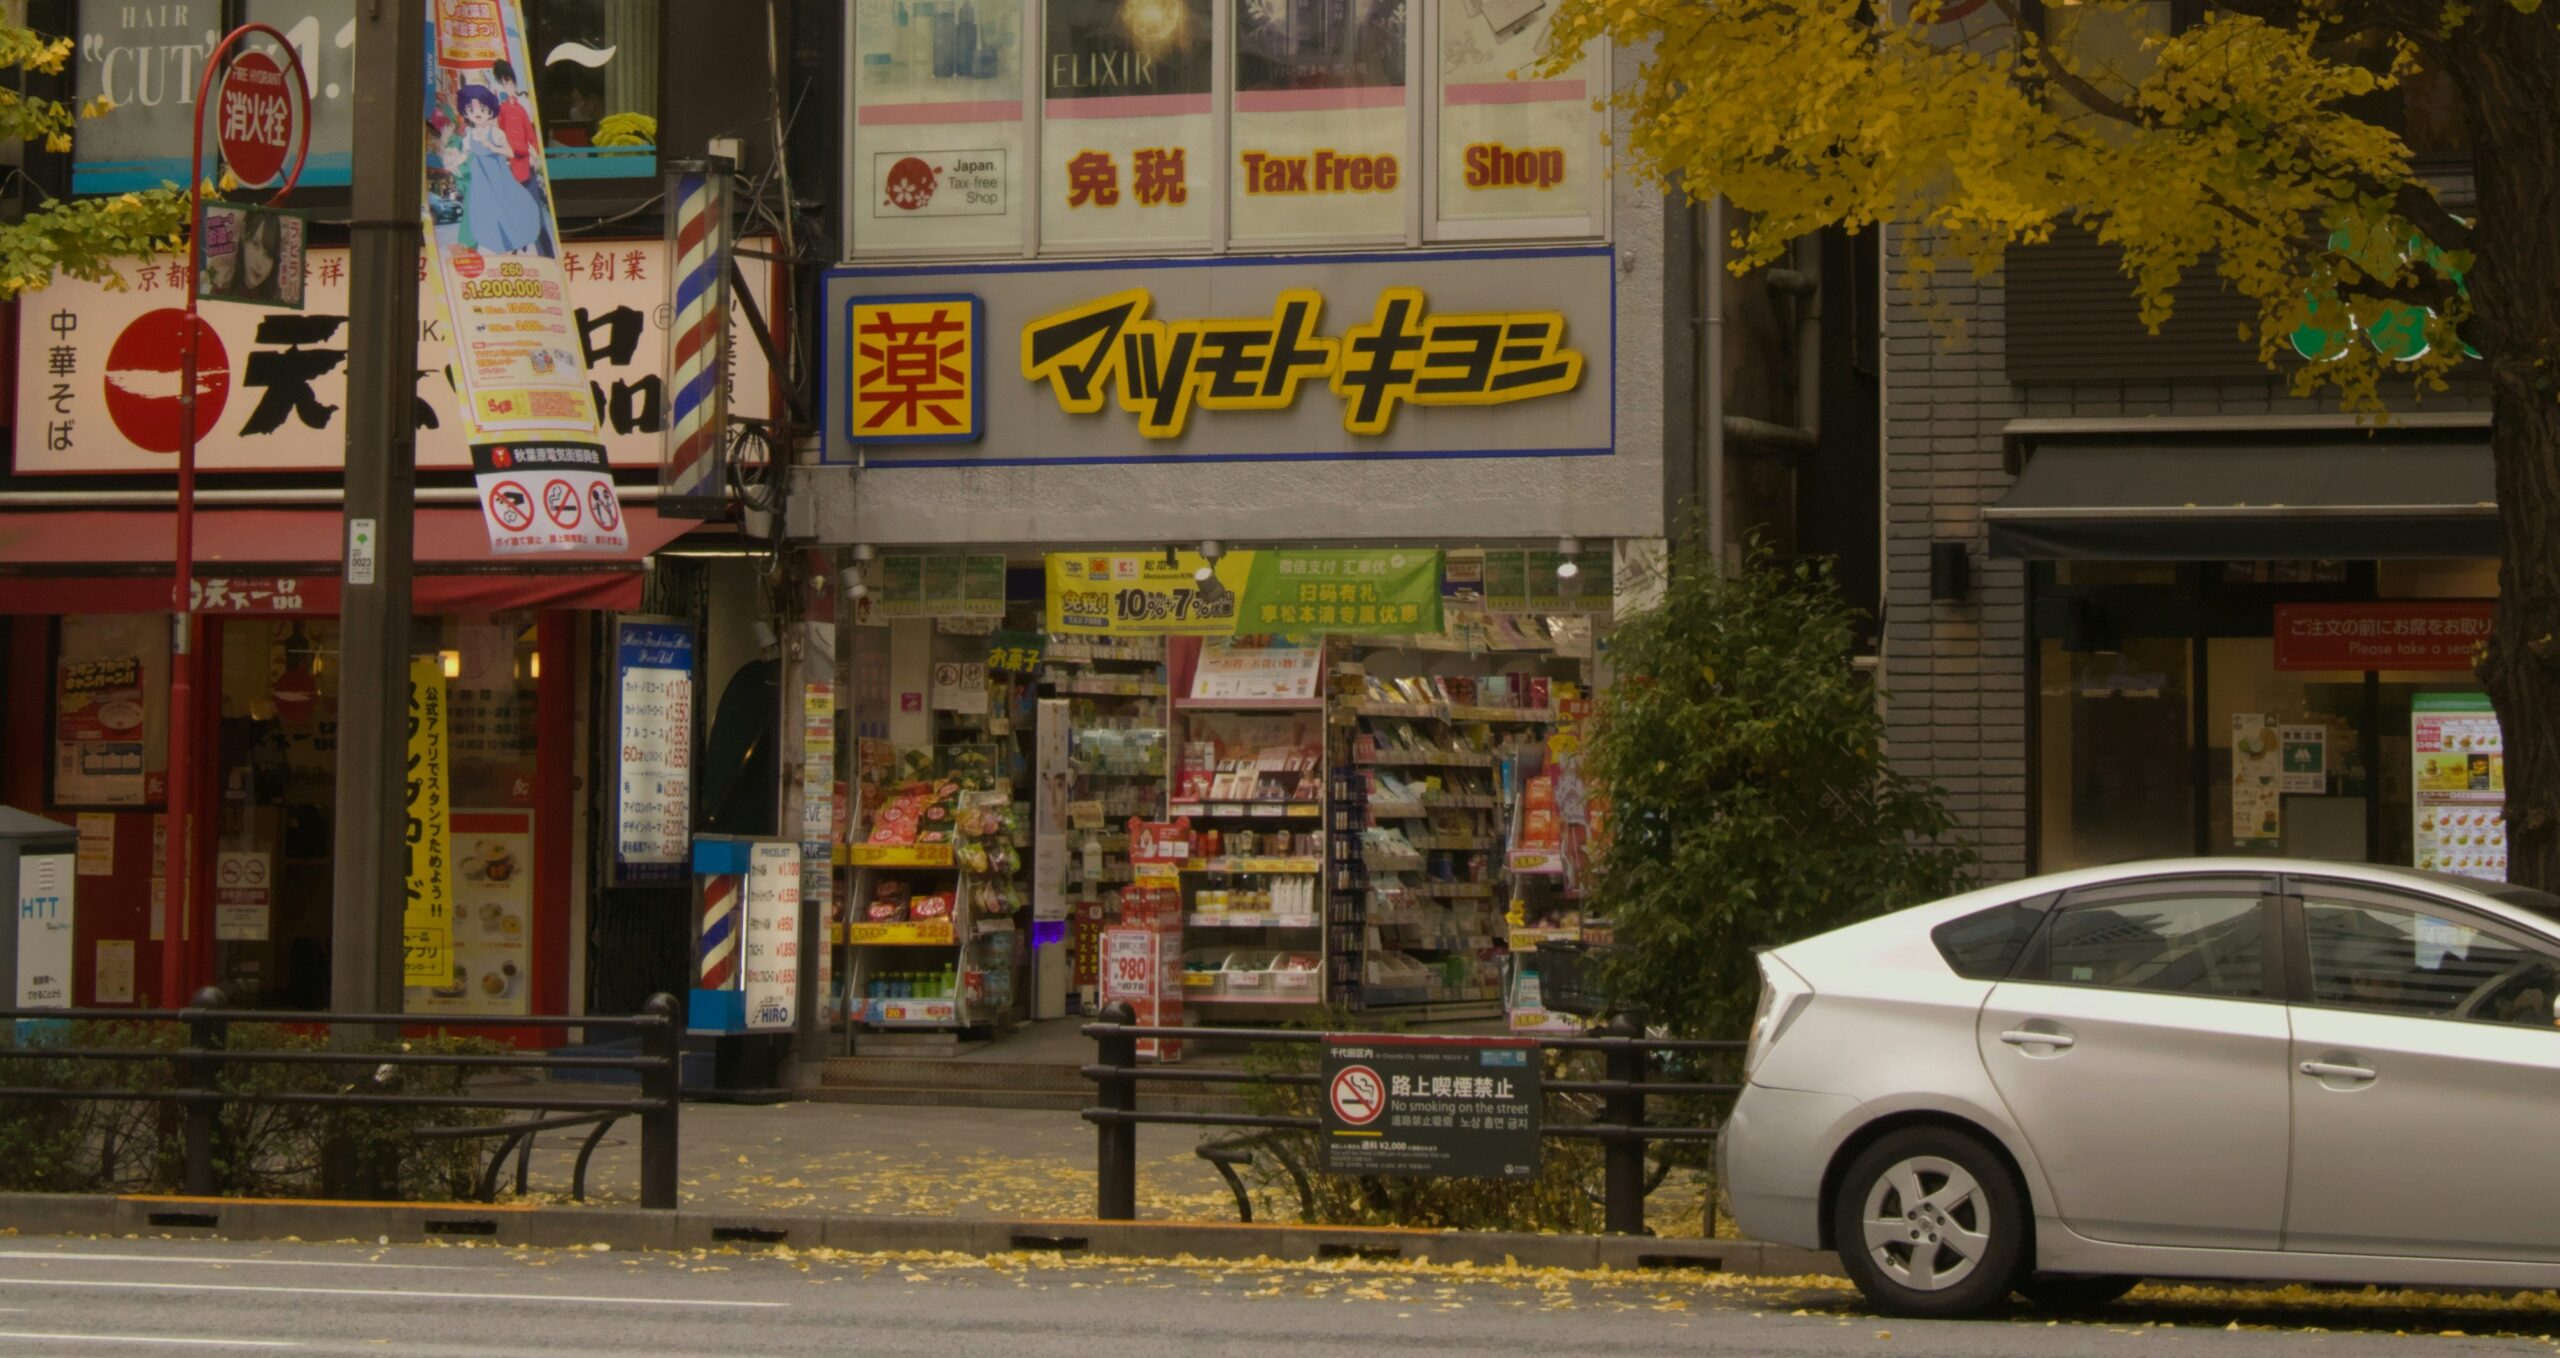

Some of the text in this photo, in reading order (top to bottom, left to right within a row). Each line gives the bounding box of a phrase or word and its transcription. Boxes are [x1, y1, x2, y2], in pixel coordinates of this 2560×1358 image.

[121, 5, 189, 28] HAIR
[232, 67, 282, 86] FIRE HYDRANT
[1052, 50, 1153, 88] ELIXIR
[224, 90, 288, 148] 消火栓
[1065, 147, 1188, 209] 免税
[1241, 149, 1399, 196] Tax Free
[1464, 143, 1566, 190] Shop
[948, 176, 998, 191] Tax-free
[966, 191, 998, 206] Shop
[857, 309, 968, 430] 薬
[1024, 289, 1582, 438] マツモトキヨシ
[48, 308, 77, 452] 中華そば
[1279, 559, 1337, 575] 微信支付
[205, 578, 302, 610] 天下一品
[1300, 583, 1377, 603] 扫码有礼
[2349, 640, 2392, 655] Please
[2398, 639, 2425, 655] take
[2432, 644, 2441, 655] a
[988, 647, 1041, 673] お菓子
[804, 808, 821, 823] EVE
[21, 896, 58, 920] HTT
[1119, 957, 1146, 981] 980
[761, 1006, 788, 1023] HIRO
[1330, 1048, 1374, 1059] 千代田区内
[1391, 1075, 1515, 1099] 路上喫煙禁止
[1391, 1100, 1529, 1116] No smoking on the street
[1379, 1141, 1407, 1151] ¥2,000
